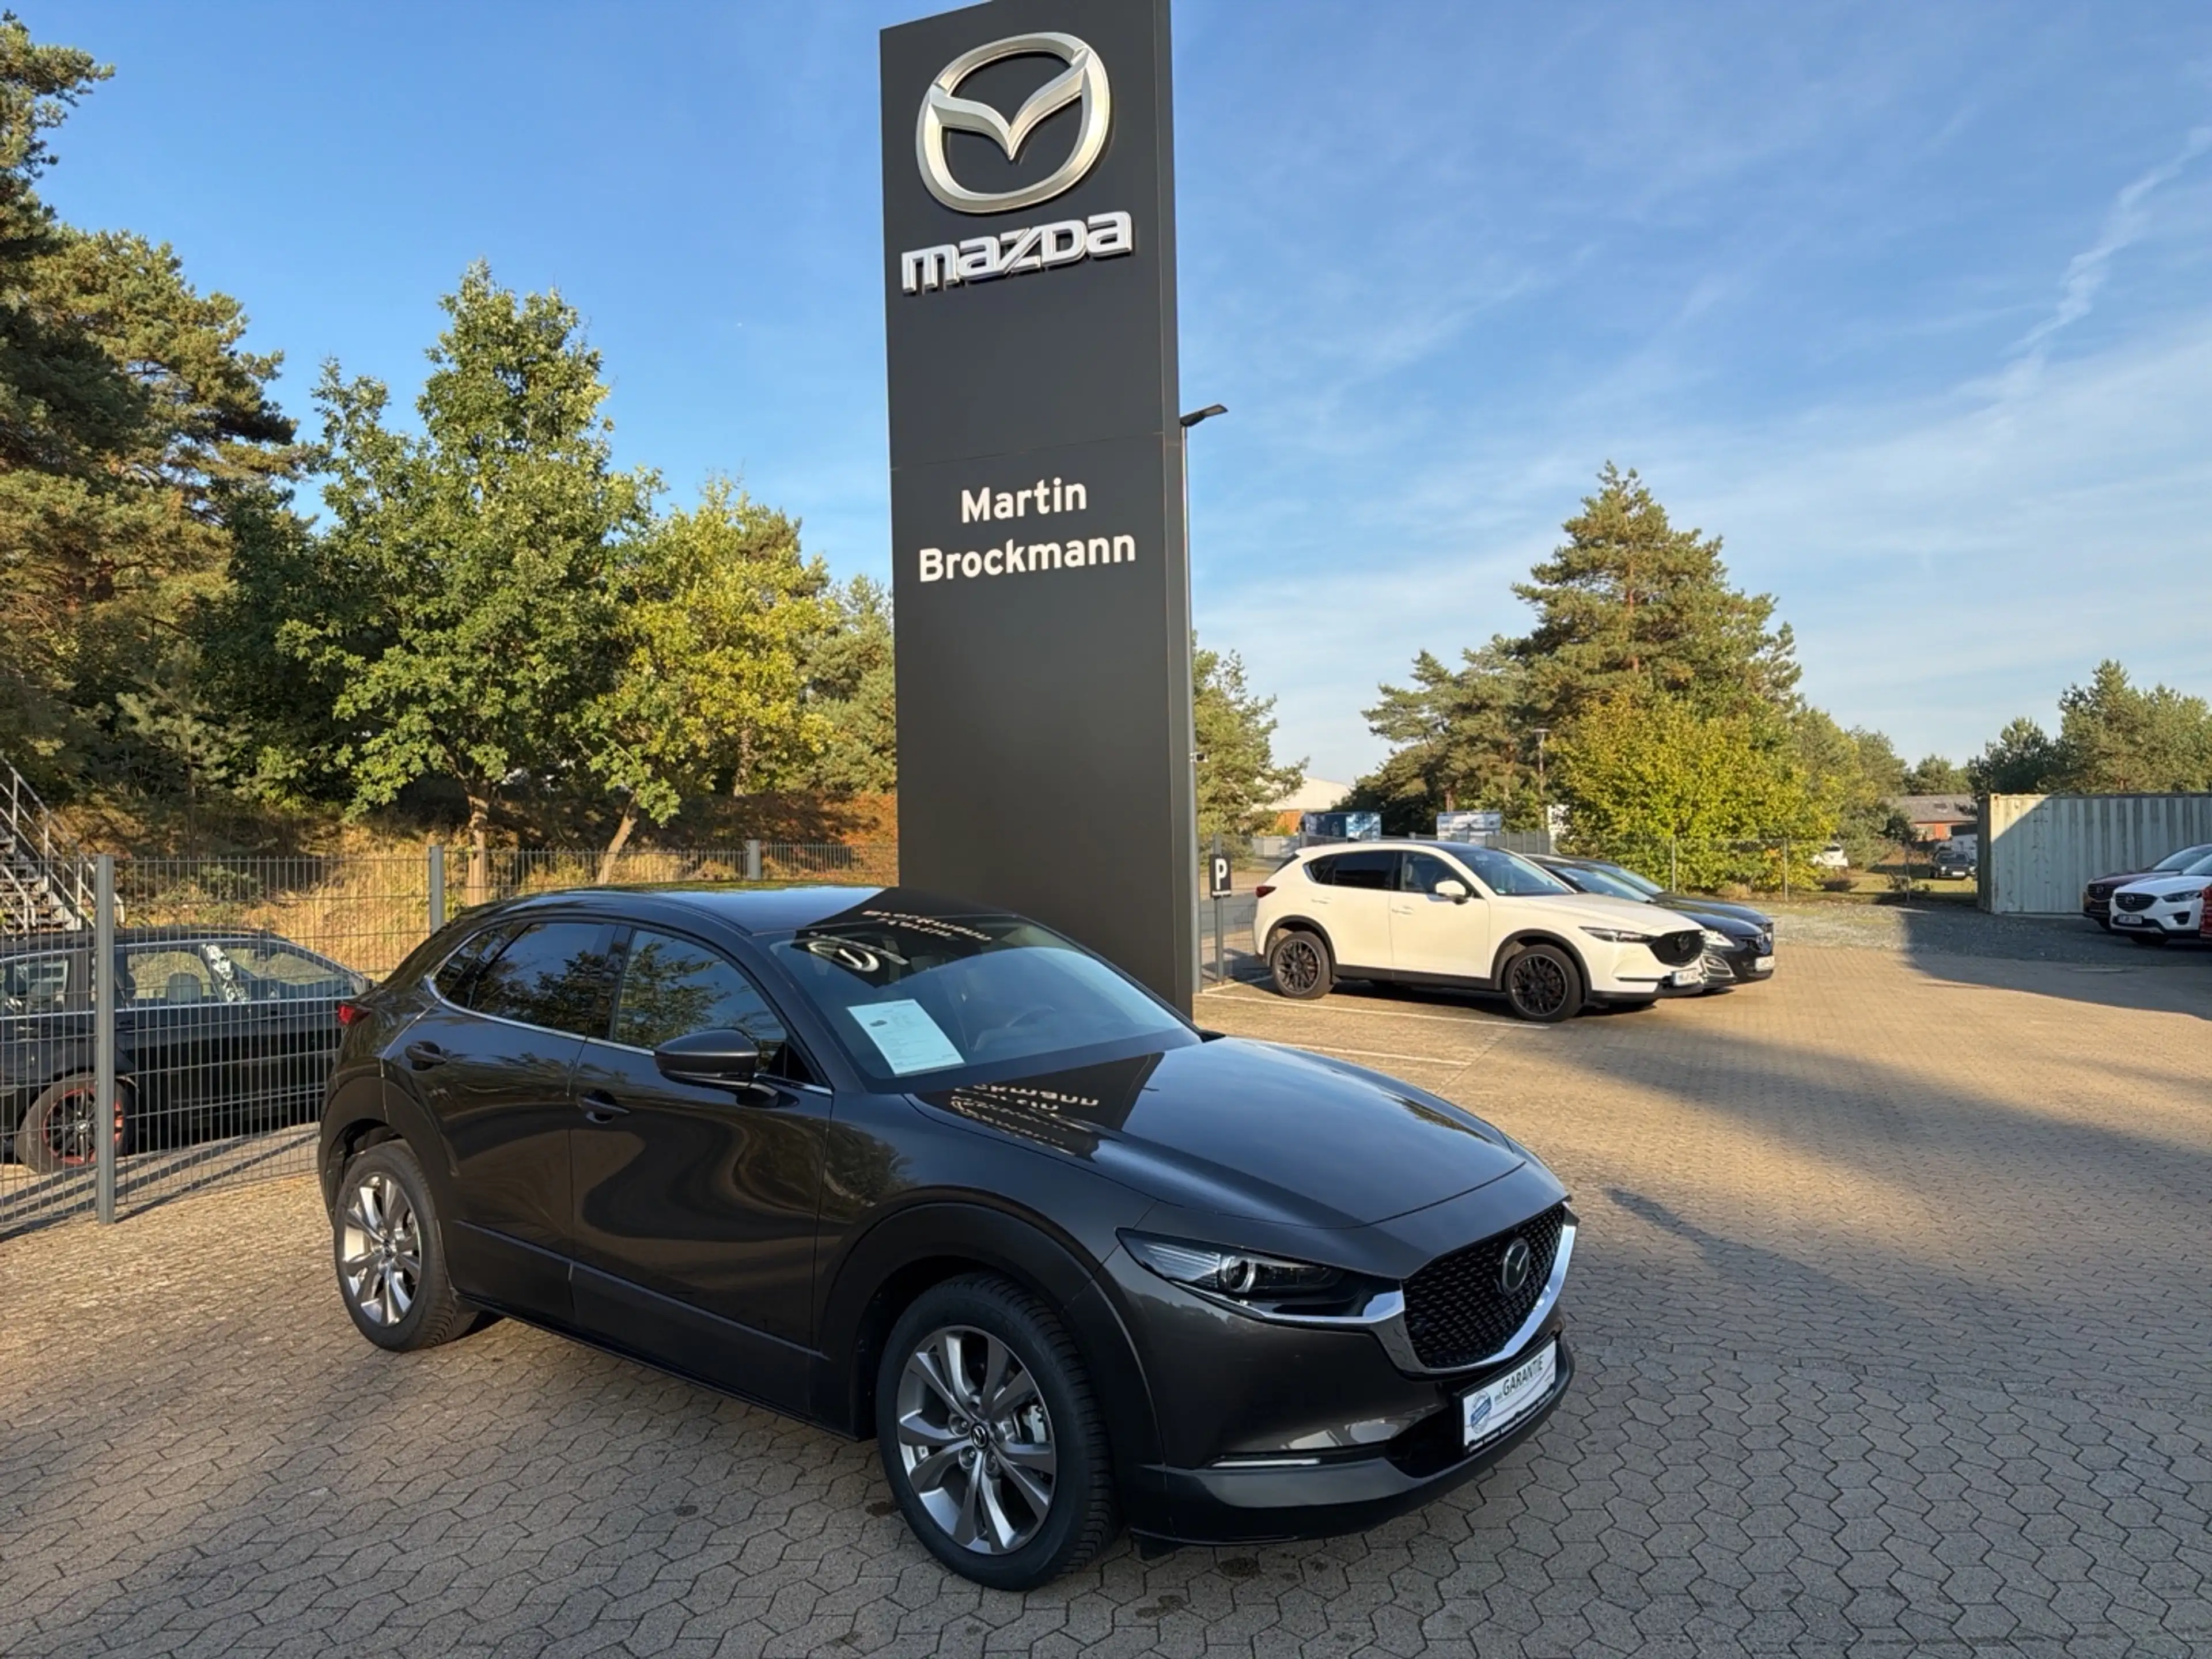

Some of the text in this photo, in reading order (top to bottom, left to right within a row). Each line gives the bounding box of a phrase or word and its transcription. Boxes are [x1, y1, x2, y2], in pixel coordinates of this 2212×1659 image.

[961, 478, 1087, 523] Martin
[920, 535, 1136, 582] Brockmann
[1215, 858, 1228, 891] P
